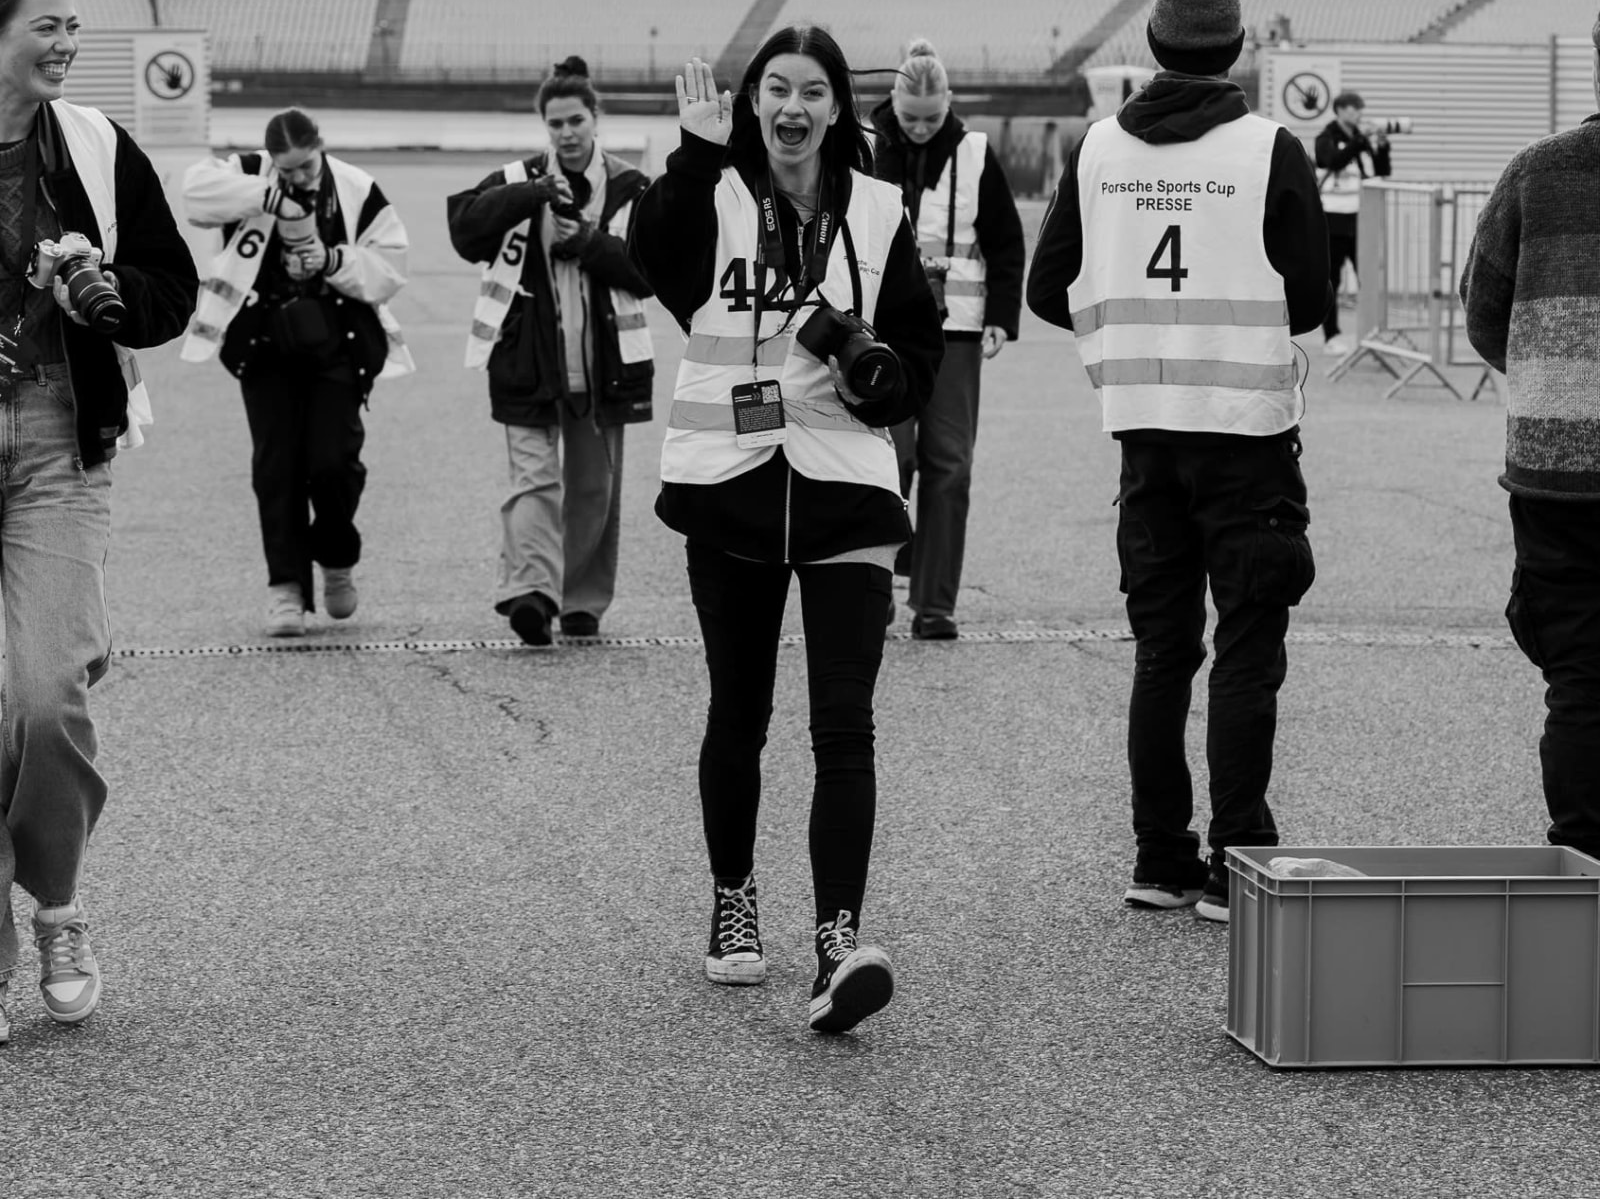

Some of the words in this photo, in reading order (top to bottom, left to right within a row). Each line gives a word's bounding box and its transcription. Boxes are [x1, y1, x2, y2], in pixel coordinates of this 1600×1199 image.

[1101, 180, 1153, 195] Porsche
[1156, 179, 1202, 196] Sports
[1206, 180, 1236, 198] Cup
[1136, 197, 1193, 211] PRESSE
[764, 209, 776, 232] EOS
[819, 211, 831, 244] Canon
[237, 228, 265, 259] 6
[502, 231, 528, 266] 5
[1146, 225, 1189, 292] 4
